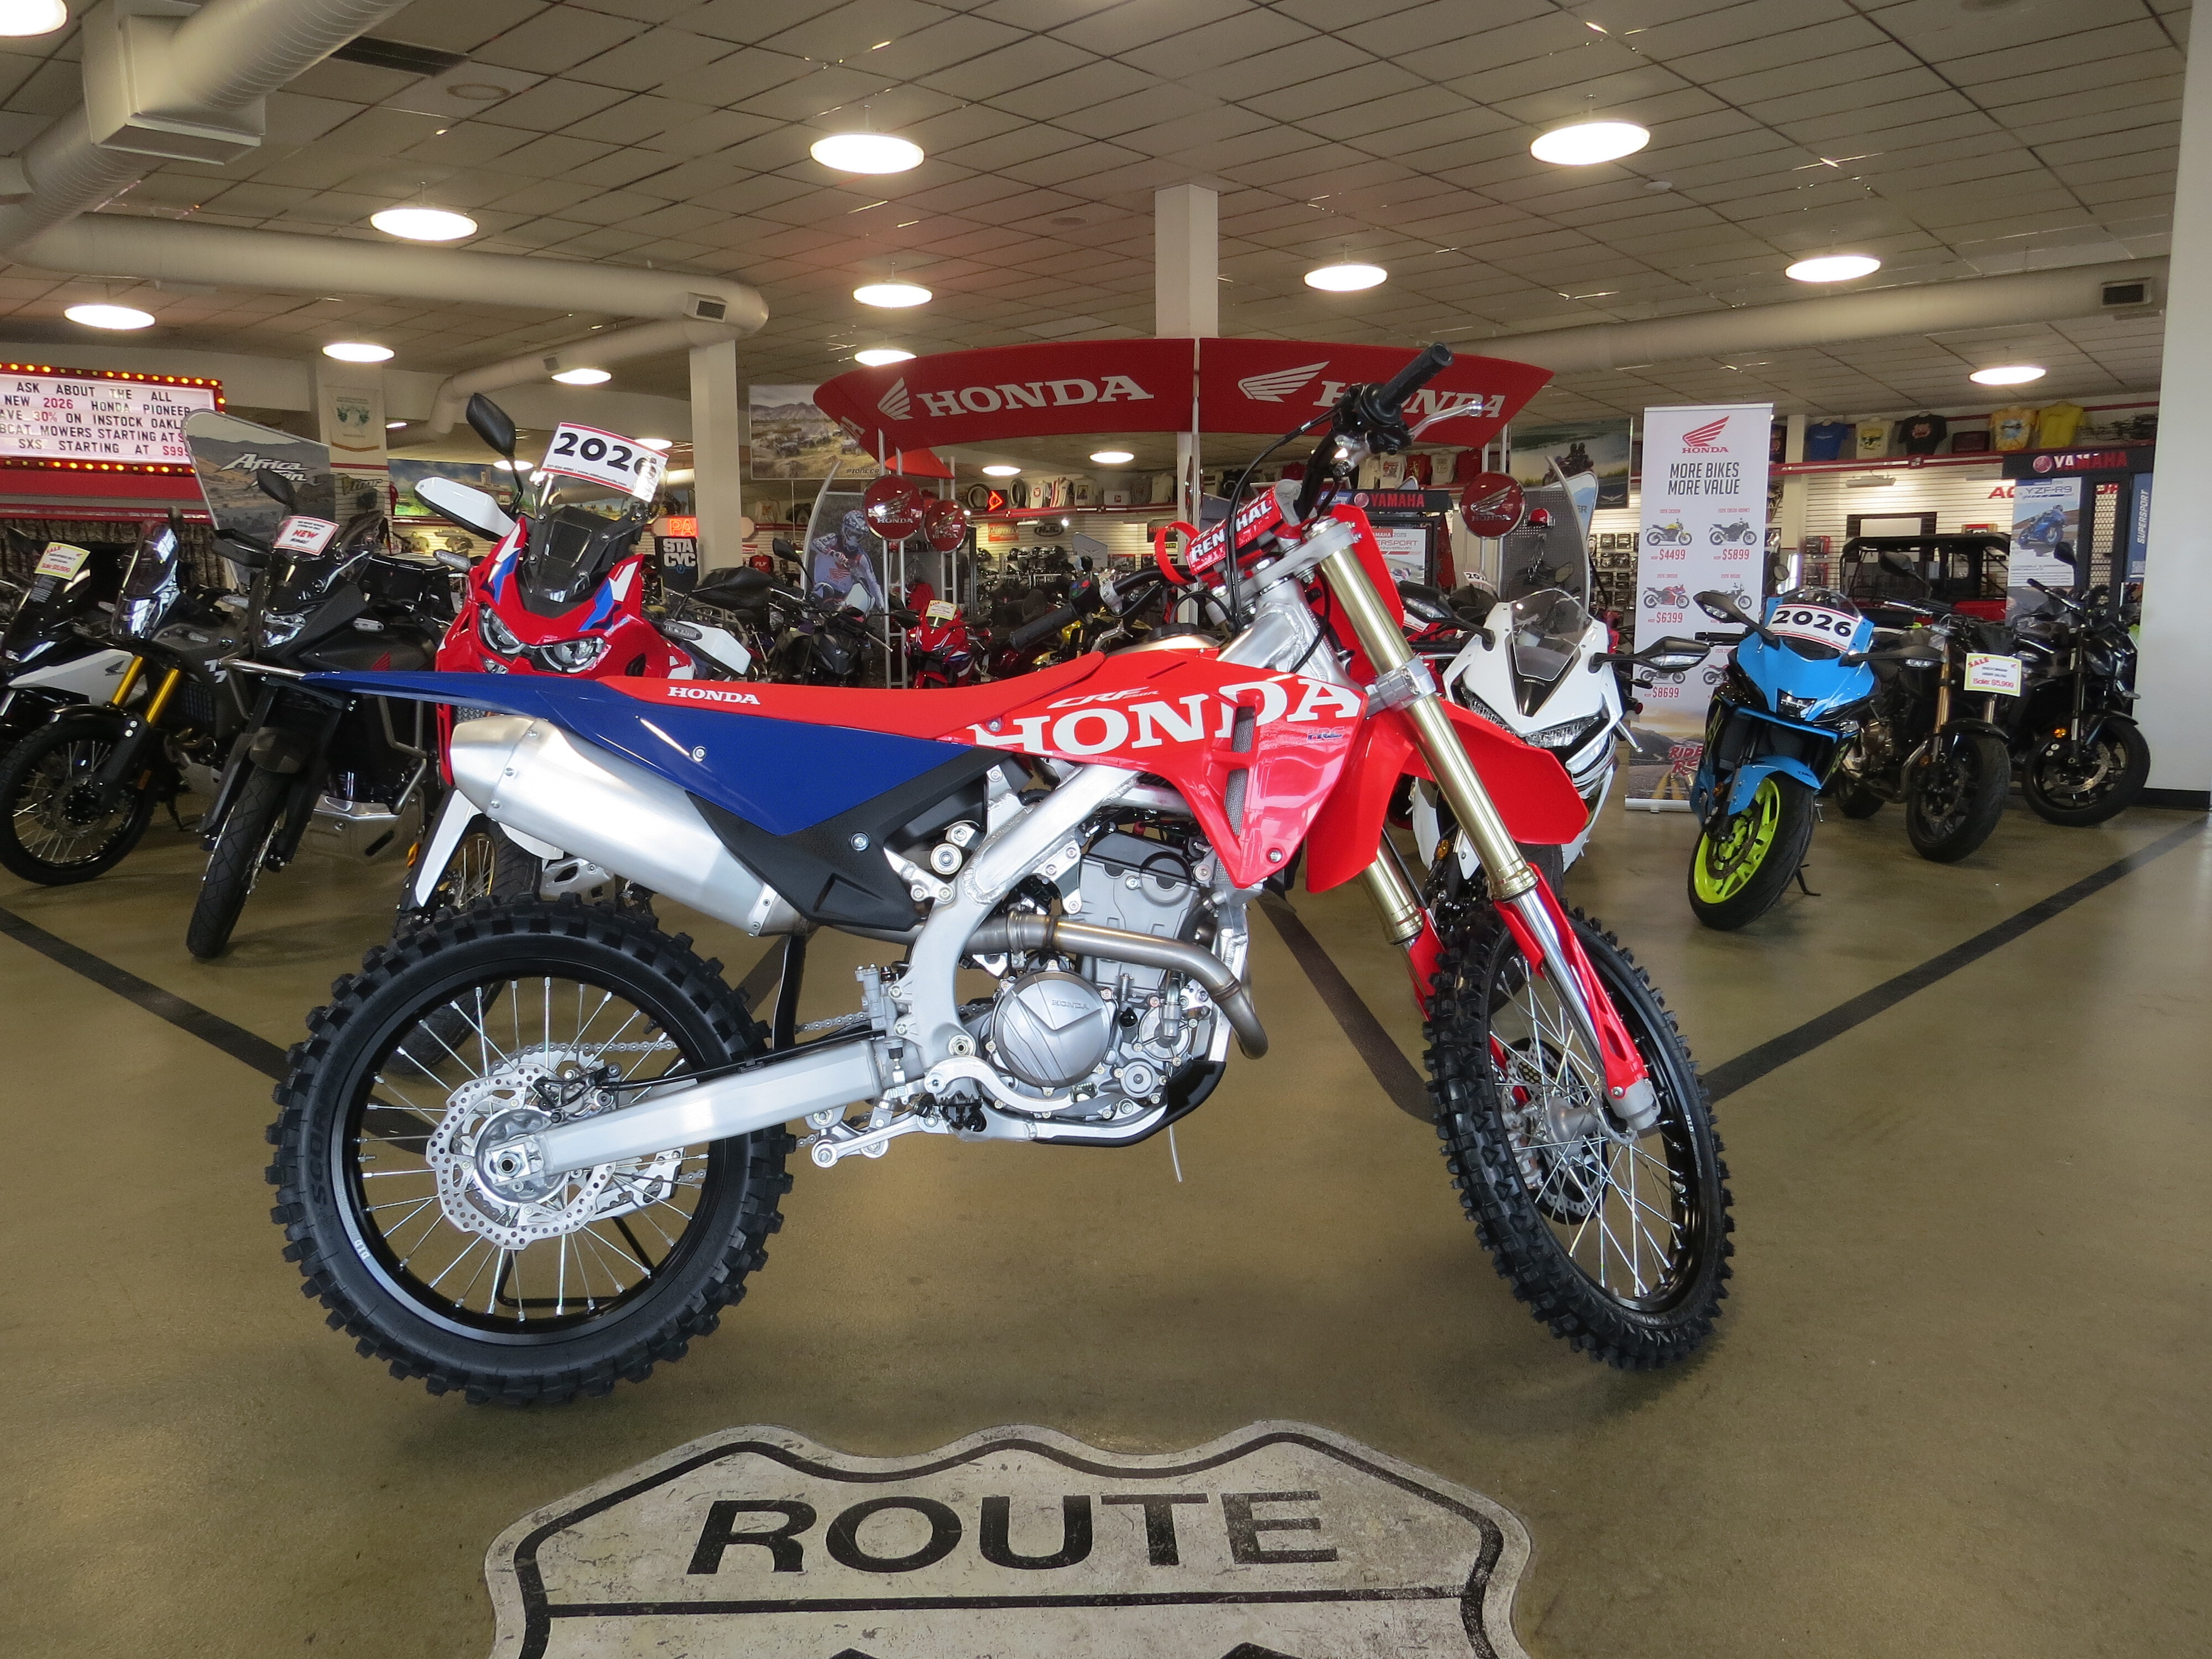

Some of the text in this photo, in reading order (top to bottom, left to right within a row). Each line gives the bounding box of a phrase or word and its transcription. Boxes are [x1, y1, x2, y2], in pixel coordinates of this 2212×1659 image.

[17, 382, 172, 402] ASK ABOUT THE ALL
[916, 375, 1154, 417] HONDA
[1313, 380, 1505, 418] HNDA
[4, 395, 190, 416] NEW 2026 HONDA PIONEER
[0, 409, 182, 429] AVE 30% ON INSTOCK OAKL
[0, 424, 31, 435] BCAT
[40, 425, 92, 438] MOWERS
[98, 429, 156, 441] STARTING
[161, 432, 175, 442] AT
[18, 439, 43, 450] SXS
[59, 441, 119, 453] STARTING
[135, 445, 149, 455] AT
[220, 452, 315, 474] Africa
[1670, 462, 1740, 478] MORE BIKES
[2053, 452, 2127, 471] YAMAHA
[1668, 479, 1740, 495] MORE VALUE
[2025, 486, 2072, 494] YZF-R9
[1370, 493, 1425, 508] YAMAHA
[2137, 489, 2150, 545] SUPERSPORT
[292, 529, 319, 539] NEW
[1191, 500, 1272, 561] RENHAL
[664, 538, 694, 552] STA
[664, 553, 696, 567] CYC
[1660, 549, 1686, 561] $4499
[1721, 549, 1750, 561] $5899
[1656, 612, 1683, 623] $6399
[1772, 610, 1851, 637] 2026
[1968, 657, 1989, 668] SALE
[667, 686, 760, 705] HONDA
[1046, 686, 1150, 709] CRF
[1652, 687, 1679, 698] $8699
[966, 678, 1363, 755] HONDA
[1668, 745, 1704, 759] RIDE
[1671, 759, 1698, 777] RE
[1051, 999, 1090, 1010] HONDA
[354, 1238, 371, 1260] DID
[686, 1489, 1338, 1575] ROUTE
